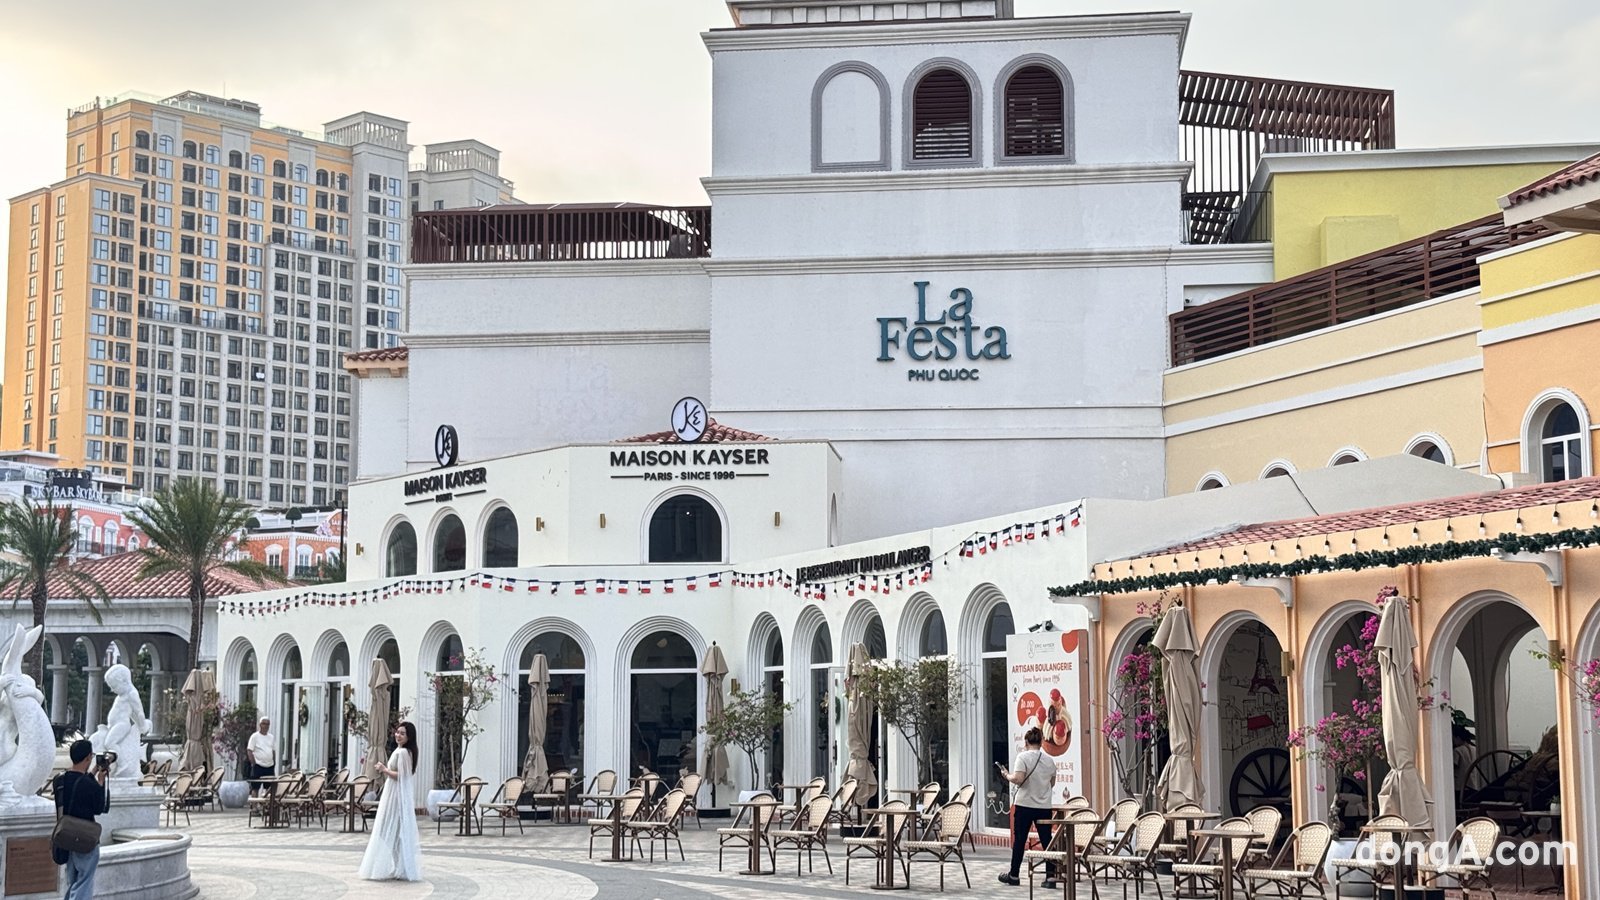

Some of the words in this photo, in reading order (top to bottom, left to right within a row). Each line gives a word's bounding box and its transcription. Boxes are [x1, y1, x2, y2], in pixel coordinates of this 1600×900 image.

[913, 281, 973, 325] La
[876, 314, 1012, 361] Festa
[908, 369, 934, 381] PHU
[938, 368, 979, 381] QUOC
[610, 450, 686, 466] MAISON
[693, 449, 769, 465] KAYSER
[404, 474, 444, 497] MAISON
[445, 467, 487, 490] KAYSER
[644, 472, 672, 481] PARIS
[680, 471, 710, 480] SINCE
[713, 471, 735, 480] 1996
[807, 557, 859, 581] RESTAURANT
[859, 555, 873, 574] DU
[873, 545, 931, 570] BOULANGER
[1012, 664, 1035, 673] ARTISAN
[1035, 662, 1072, 672] BOULANGERIE
